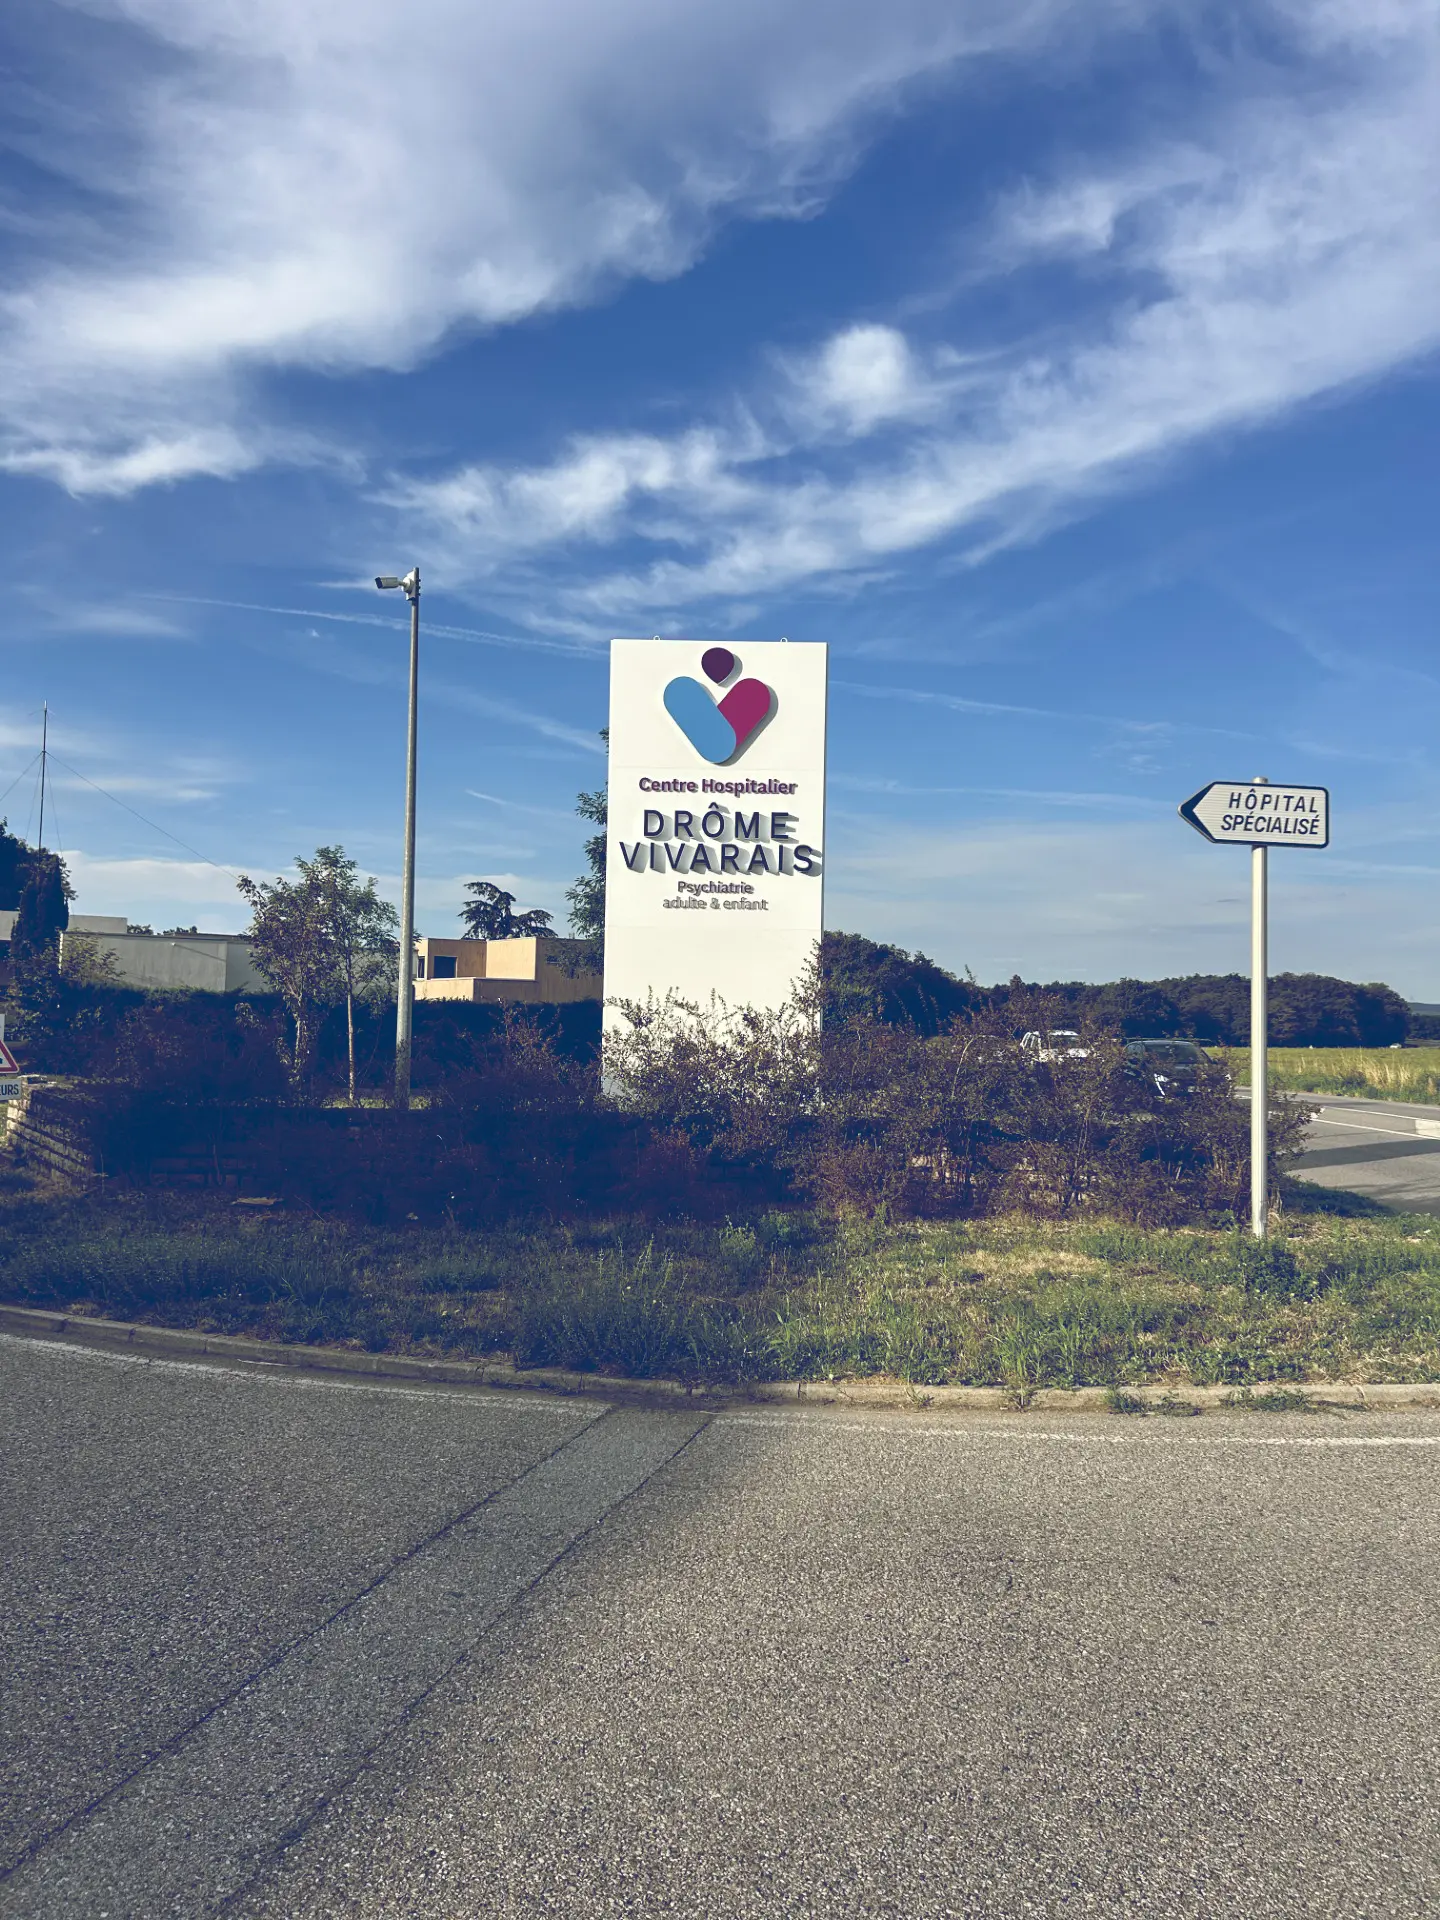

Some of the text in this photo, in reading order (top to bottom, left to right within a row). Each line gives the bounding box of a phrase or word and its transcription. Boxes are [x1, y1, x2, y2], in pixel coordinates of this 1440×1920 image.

[639, 777, 797, 797] Centre Hospitalier
[1228, 788, 1318, 813] HÔPITAL
[644, 802, 790, 840] DRÔME
[1221, 812, 1320, 835] SPÉCIALISÉ
[619, 841, 814, 874] VIVARAIS
[678, 881, 754, 896] Psychiatrie
[663, 898, 768, 910] adulte & enfant
[0, 1084, 19, 1095] URS
